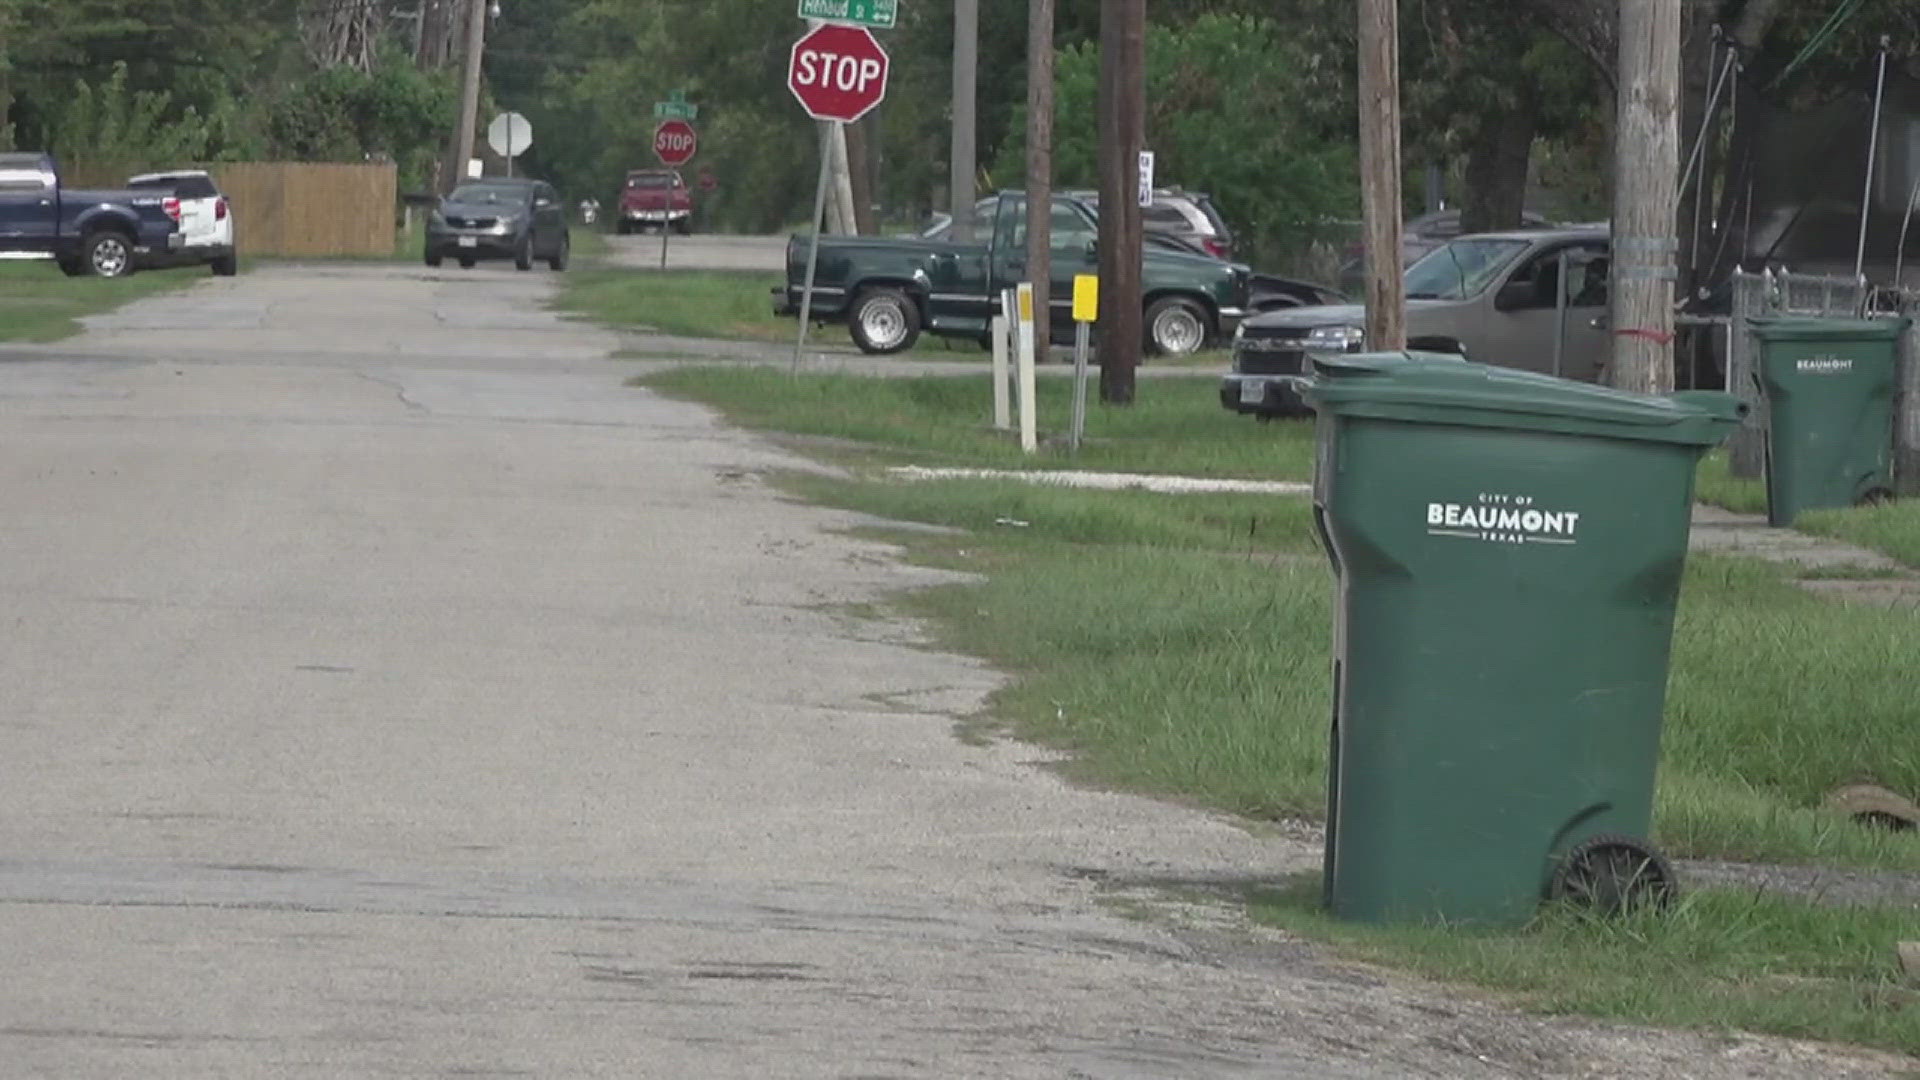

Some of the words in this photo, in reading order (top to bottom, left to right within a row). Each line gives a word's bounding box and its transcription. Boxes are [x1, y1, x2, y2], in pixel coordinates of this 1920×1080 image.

[797, 49, 880, 93] STOP
[657, 132, 692, 151] STOP
[1797, 359, 1853, 369] BEAUMONT
[1478, 492, 1509, 504] CITY
[1515, 495, 1533, 505] OF
[1427, 502, 1579, 535] BEAUMONT
[1481, 531, 1524, 544] TEXAS
